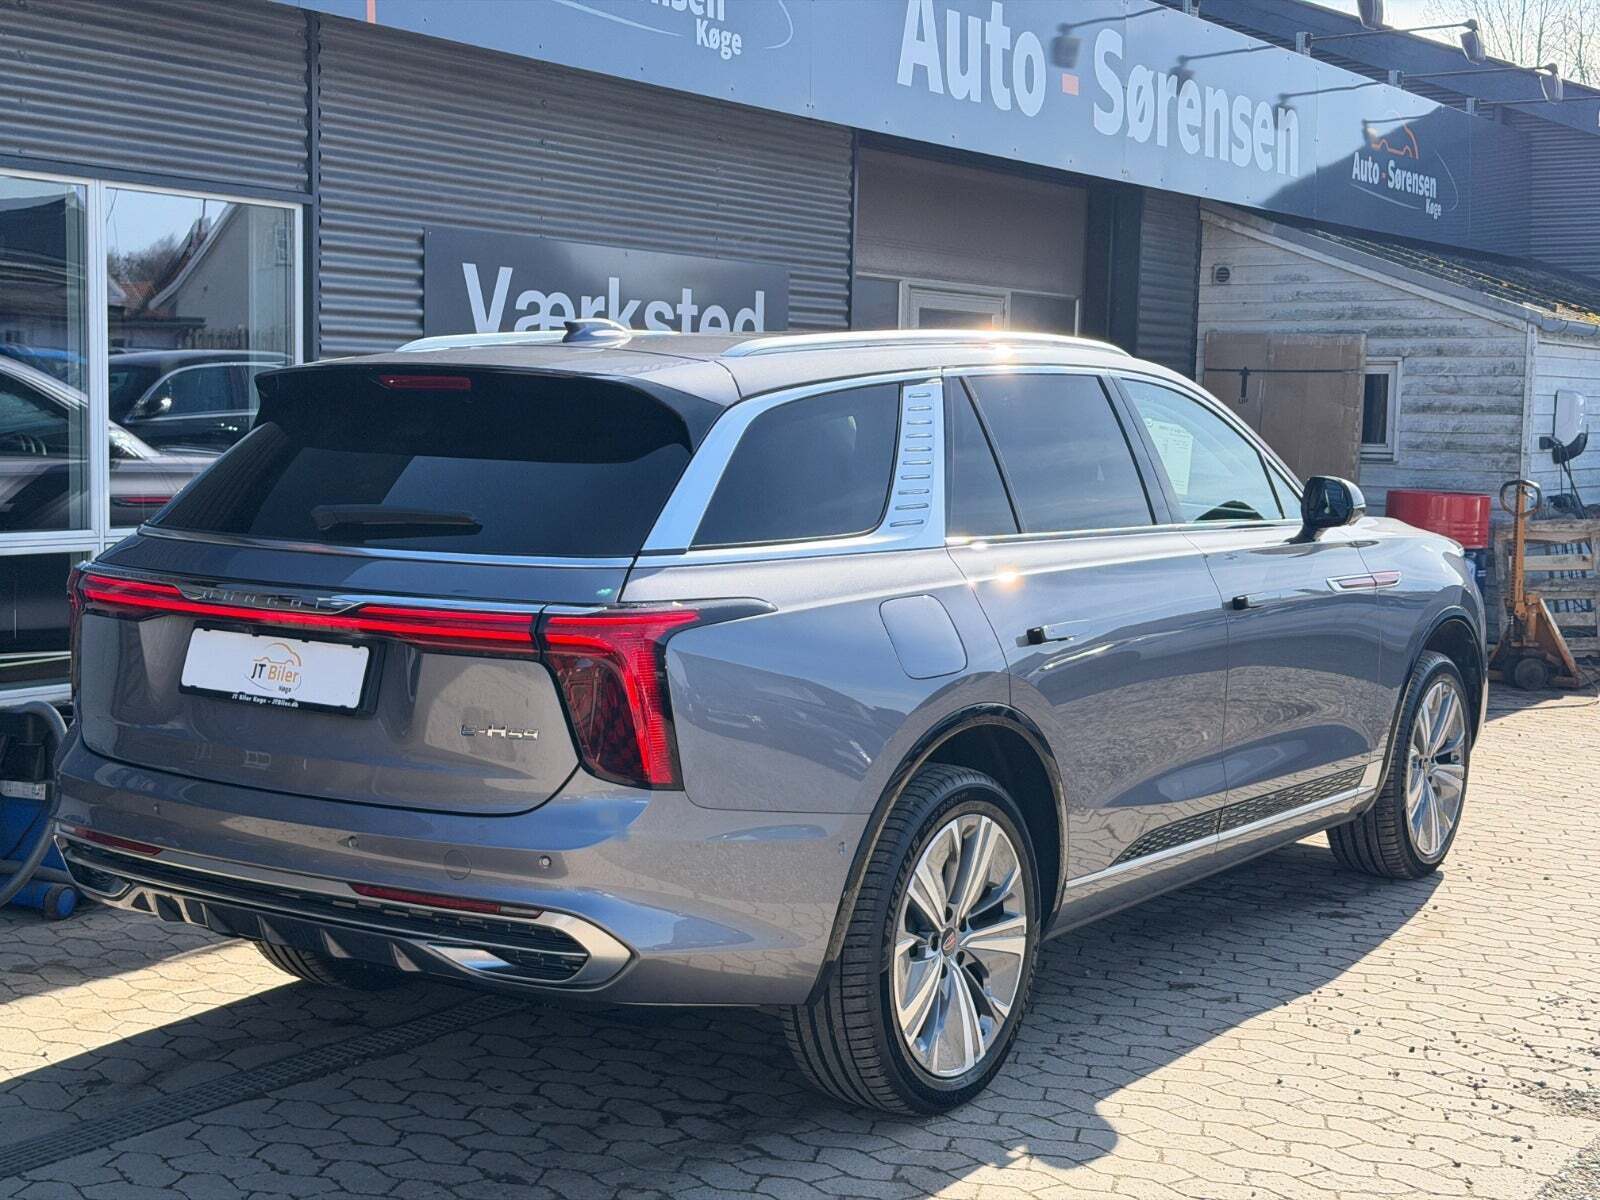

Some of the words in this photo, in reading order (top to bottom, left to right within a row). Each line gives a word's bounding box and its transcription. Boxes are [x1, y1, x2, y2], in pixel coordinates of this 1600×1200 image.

[696, 17, 742, 60] Køge
[897, 0, 1047, 118] Auto
[1093, 28, 1300, 178] Sørensen
[1351, 151, 1380, 185] Auto
[1387, 159, 1437, 199] Sørensen
[250, 663, 267, 679] JT
[267, 664, 300, 683] Biler
